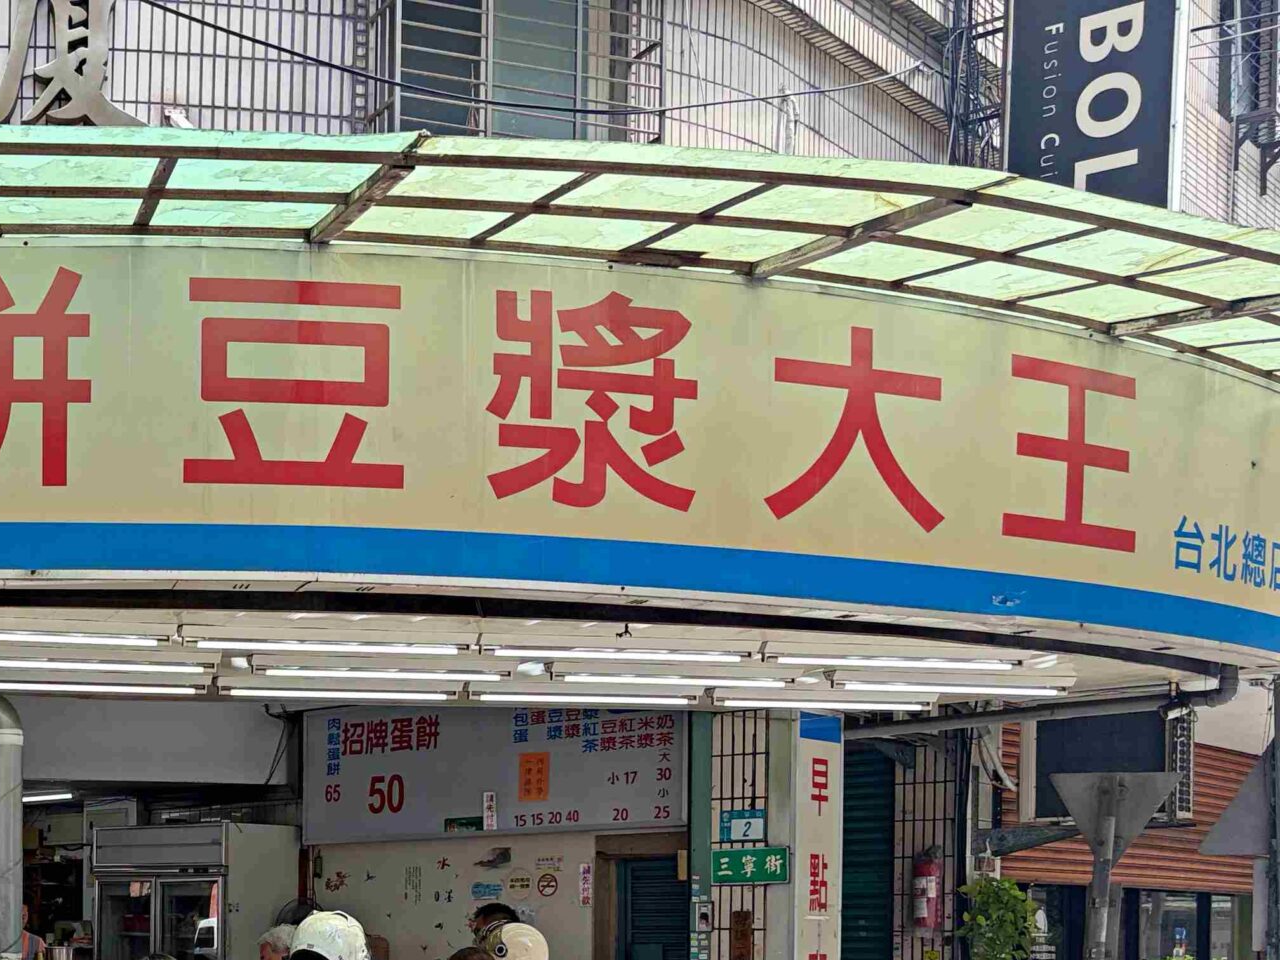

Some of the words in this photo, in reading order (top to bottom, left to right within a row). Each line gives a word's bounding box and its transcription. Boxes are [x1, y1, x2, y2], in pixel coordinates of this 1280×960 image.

[1042, 22, 1065, 118] Fusion
[341, 715, 440, 756] 招牌蛋餅
[623, 771, 638, 785] 17
[656, 767, 672, 782] 30
[325, 784, 341, 802] 65
[368, 774, 405, 814] 50
[514, 815, 527, 827] 15
[531, 813, 543, 826] 15
[548, 811, 562, 824] 20
[565, 810, 579, 823] 40
[612, 808, 628, 821] 20
[654, 805, 670, 819] 25
[742, 821, 752, 837] 2
[717, 854, 783, 877] 三寧街
